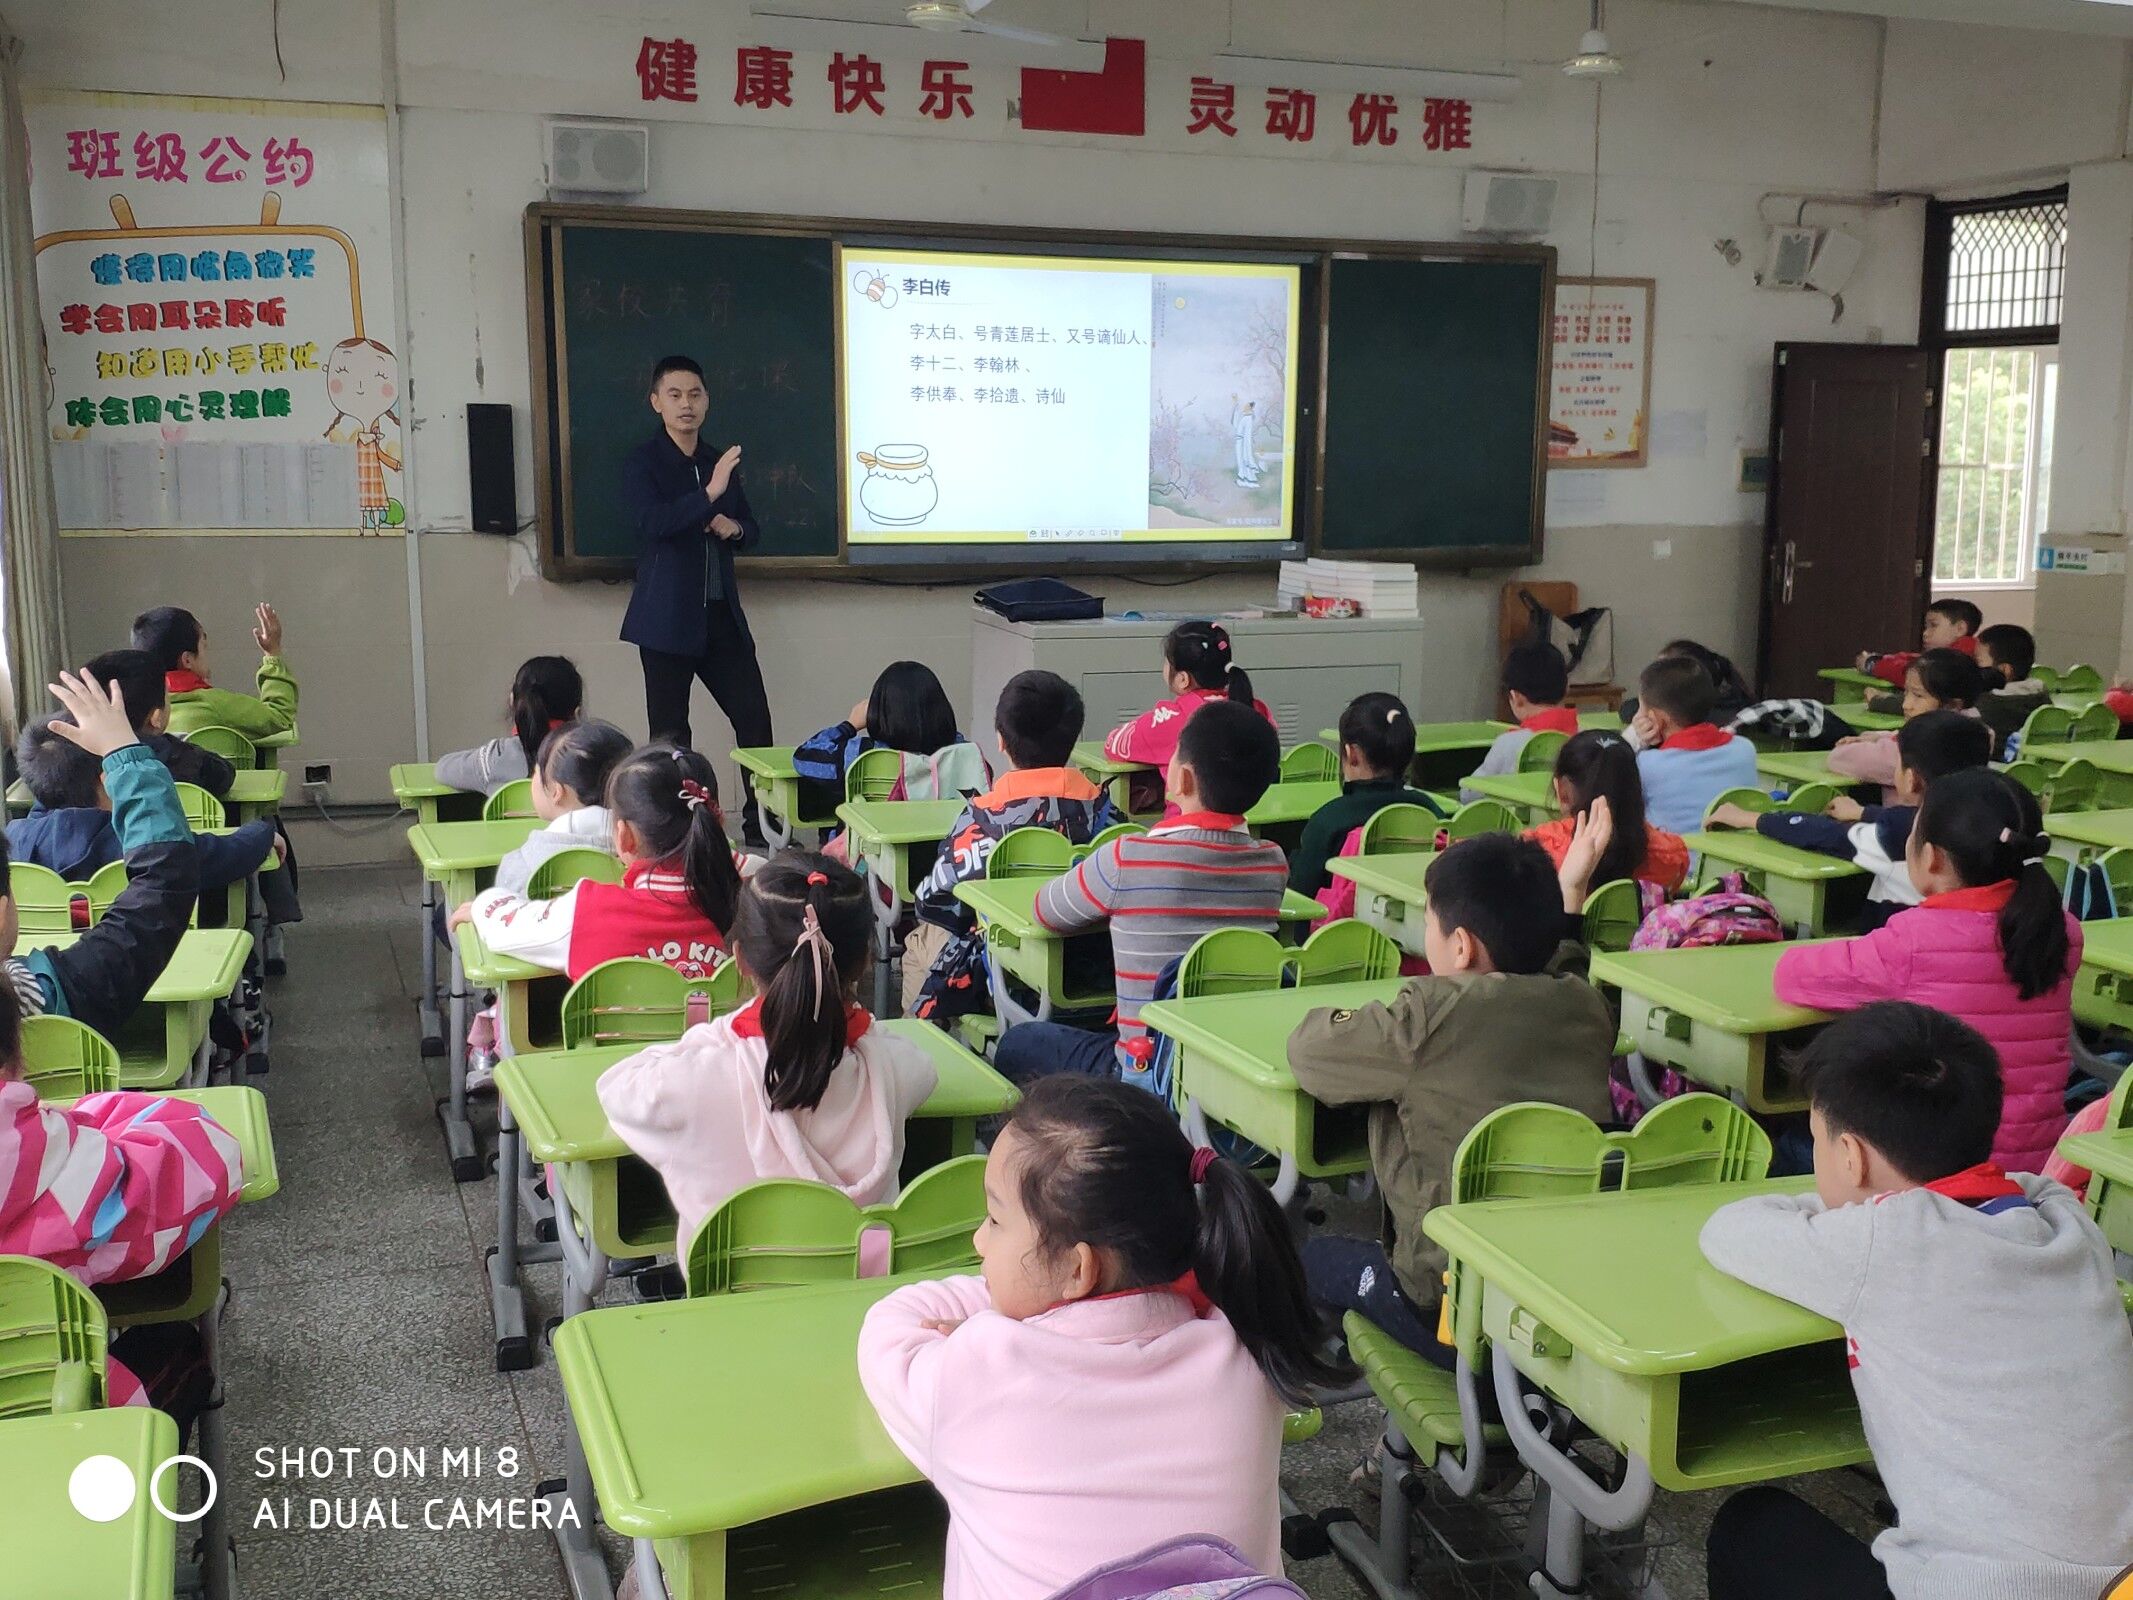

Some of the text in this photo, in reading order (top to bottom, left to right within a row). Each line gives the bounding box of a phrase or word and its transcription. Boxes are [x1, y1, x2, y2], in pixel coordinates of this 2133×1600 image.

[635, 37, 1472, 151] 健康快乐 灵动优雅
[66, 128, 315, 188] 班级公约
[90, 248, 317, 286] 懂得用嘴角微笑
[902, 278, 951, 297] 李白传
[60, 296, 287, 335] 学会用耳朵聆听
[96, 341, 320, 380] 知道用小手帮忙
[65, 388, 293, 428] 体会用心灵理解
